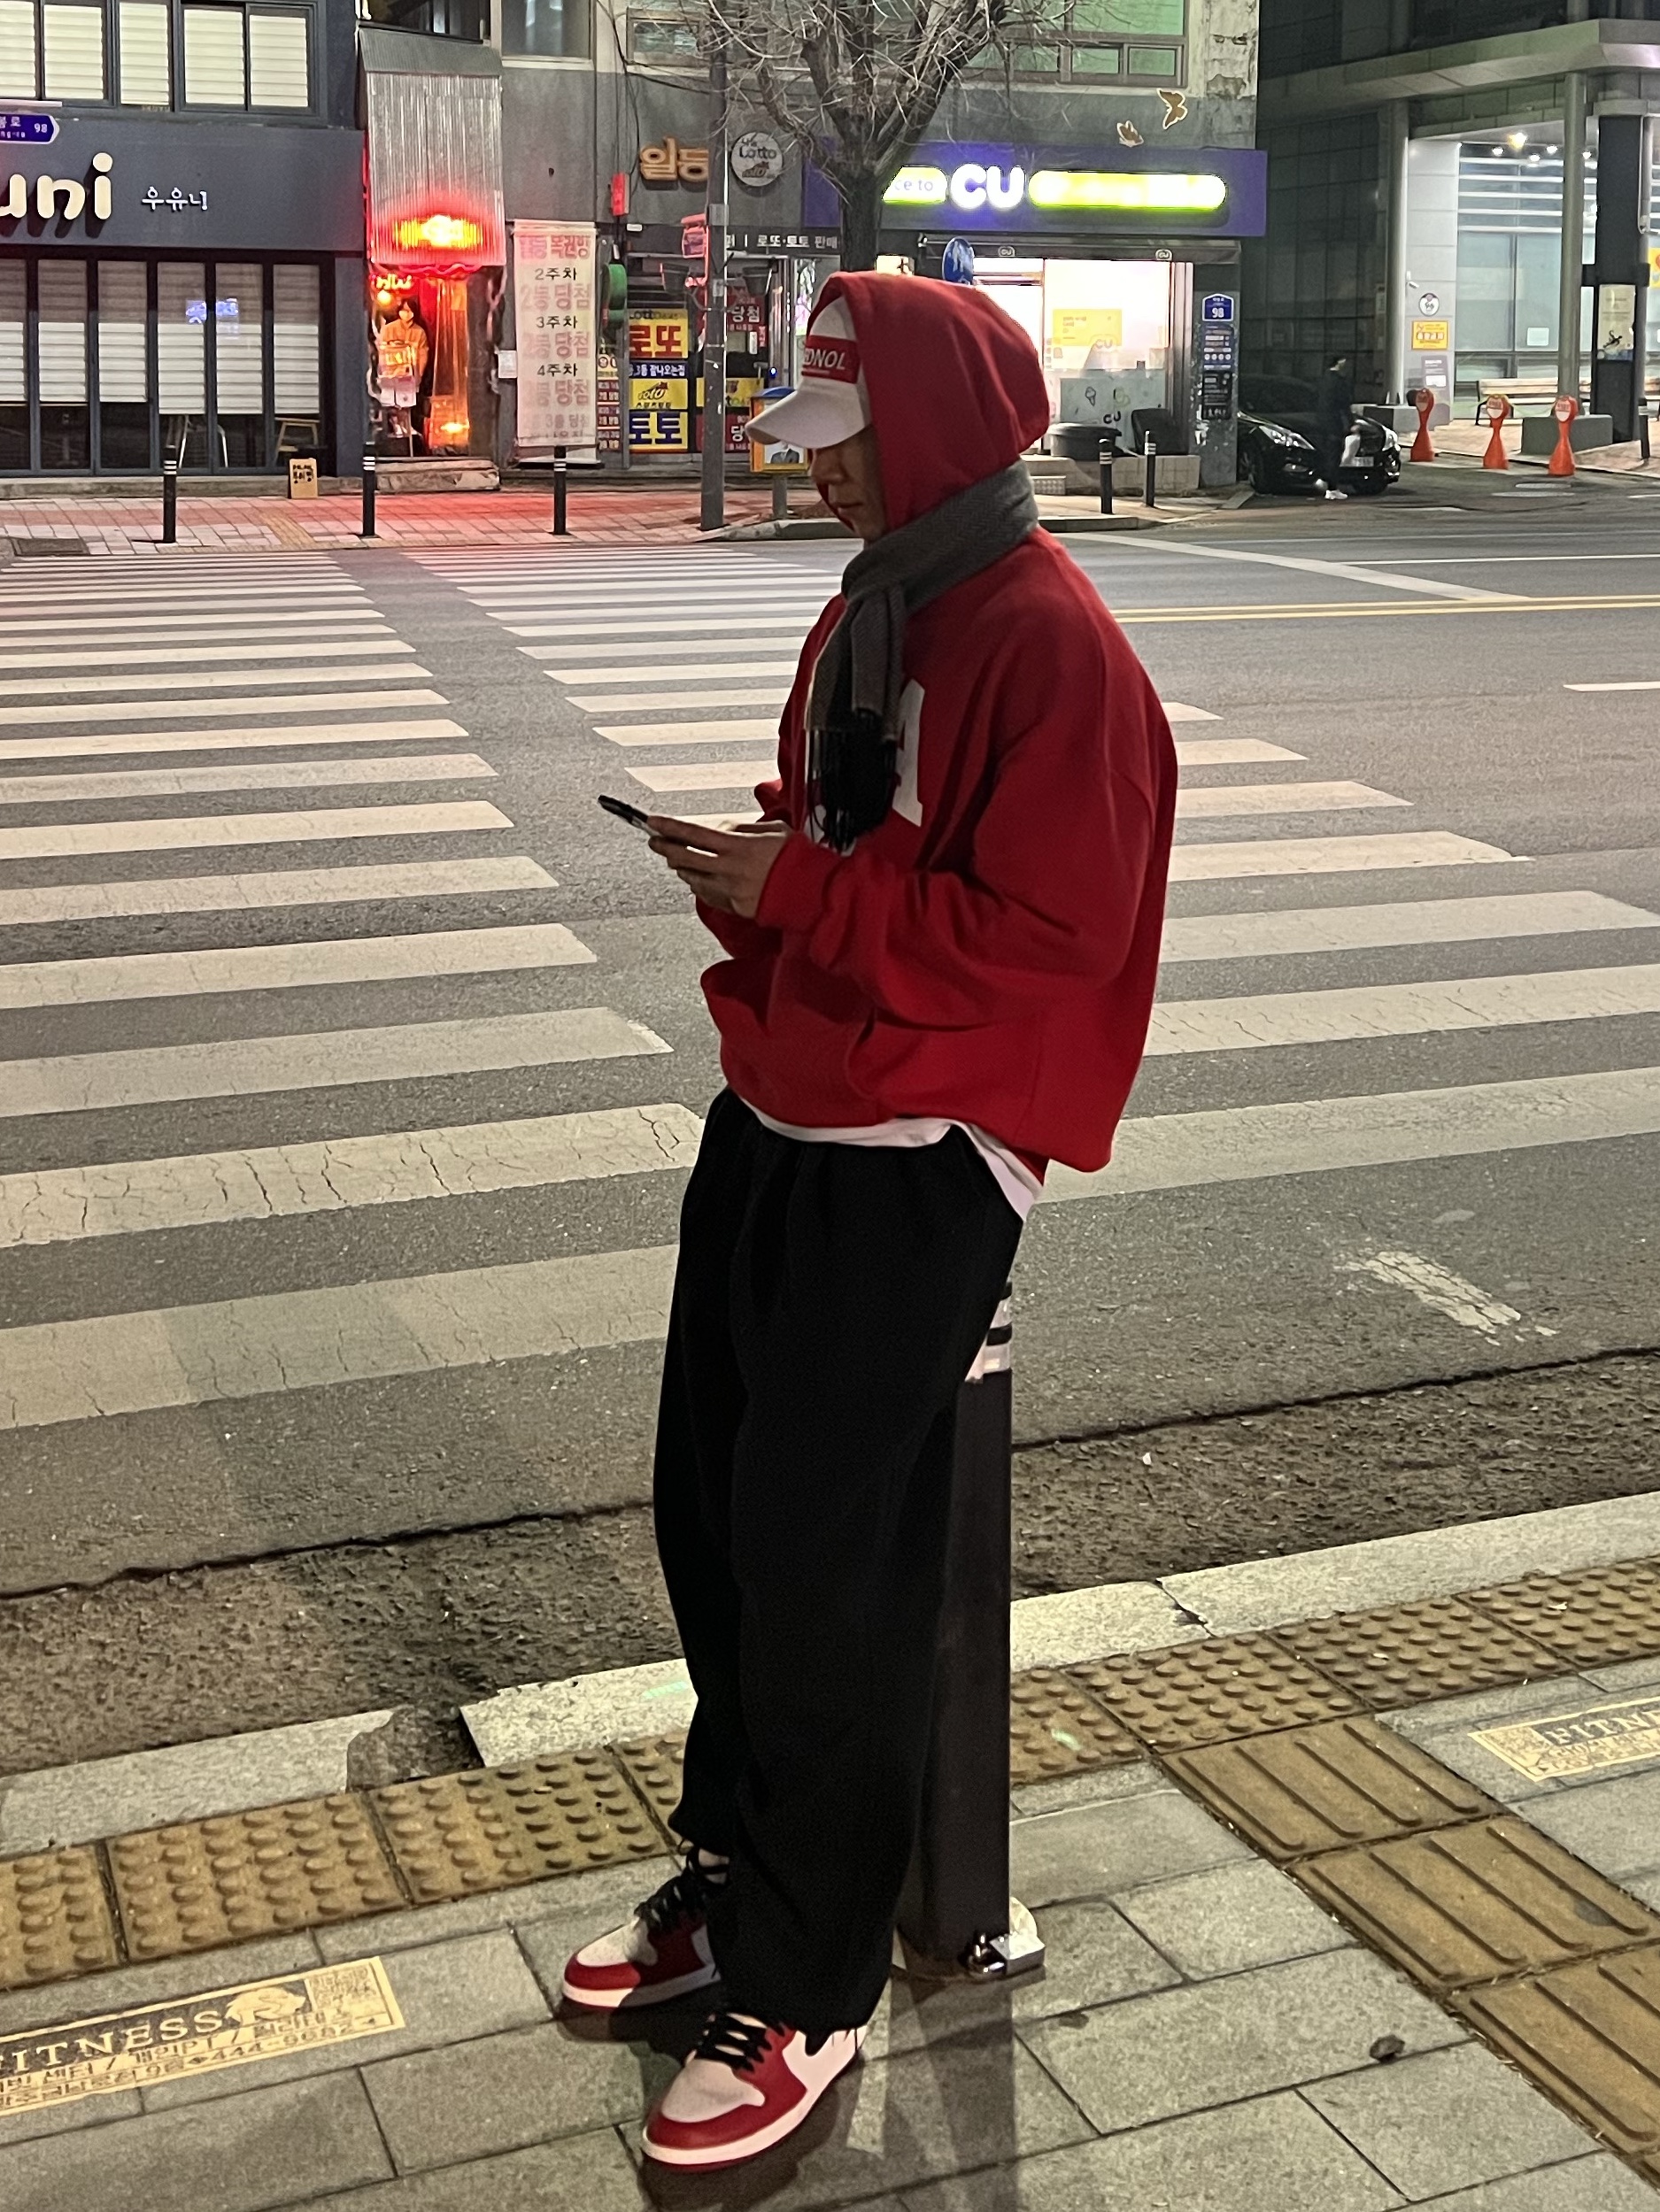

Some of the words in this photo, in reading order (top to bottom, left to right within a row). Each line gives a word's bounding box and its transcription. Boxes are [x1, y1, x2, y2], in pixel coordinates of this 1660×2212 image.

[739, 146, 776, 158] Lotto
[950, 163, 1025, 210] CU
[142, 186, 208, 212] 우유니
[535, 267, 576, 281] 2주차
[554, 283, 591, 311] 당첨
[537, 315, 577, 328] 3주차
[1211, 307, 1224, 319] 98
[629, 325, 683, 358] 로또
[537, 363, 578, 377] 4주차
[1103, 411, 1122, 424] CU
[629, 412, 683, 444] 토토
[0, 2010, 222, 2074] ITNESS
